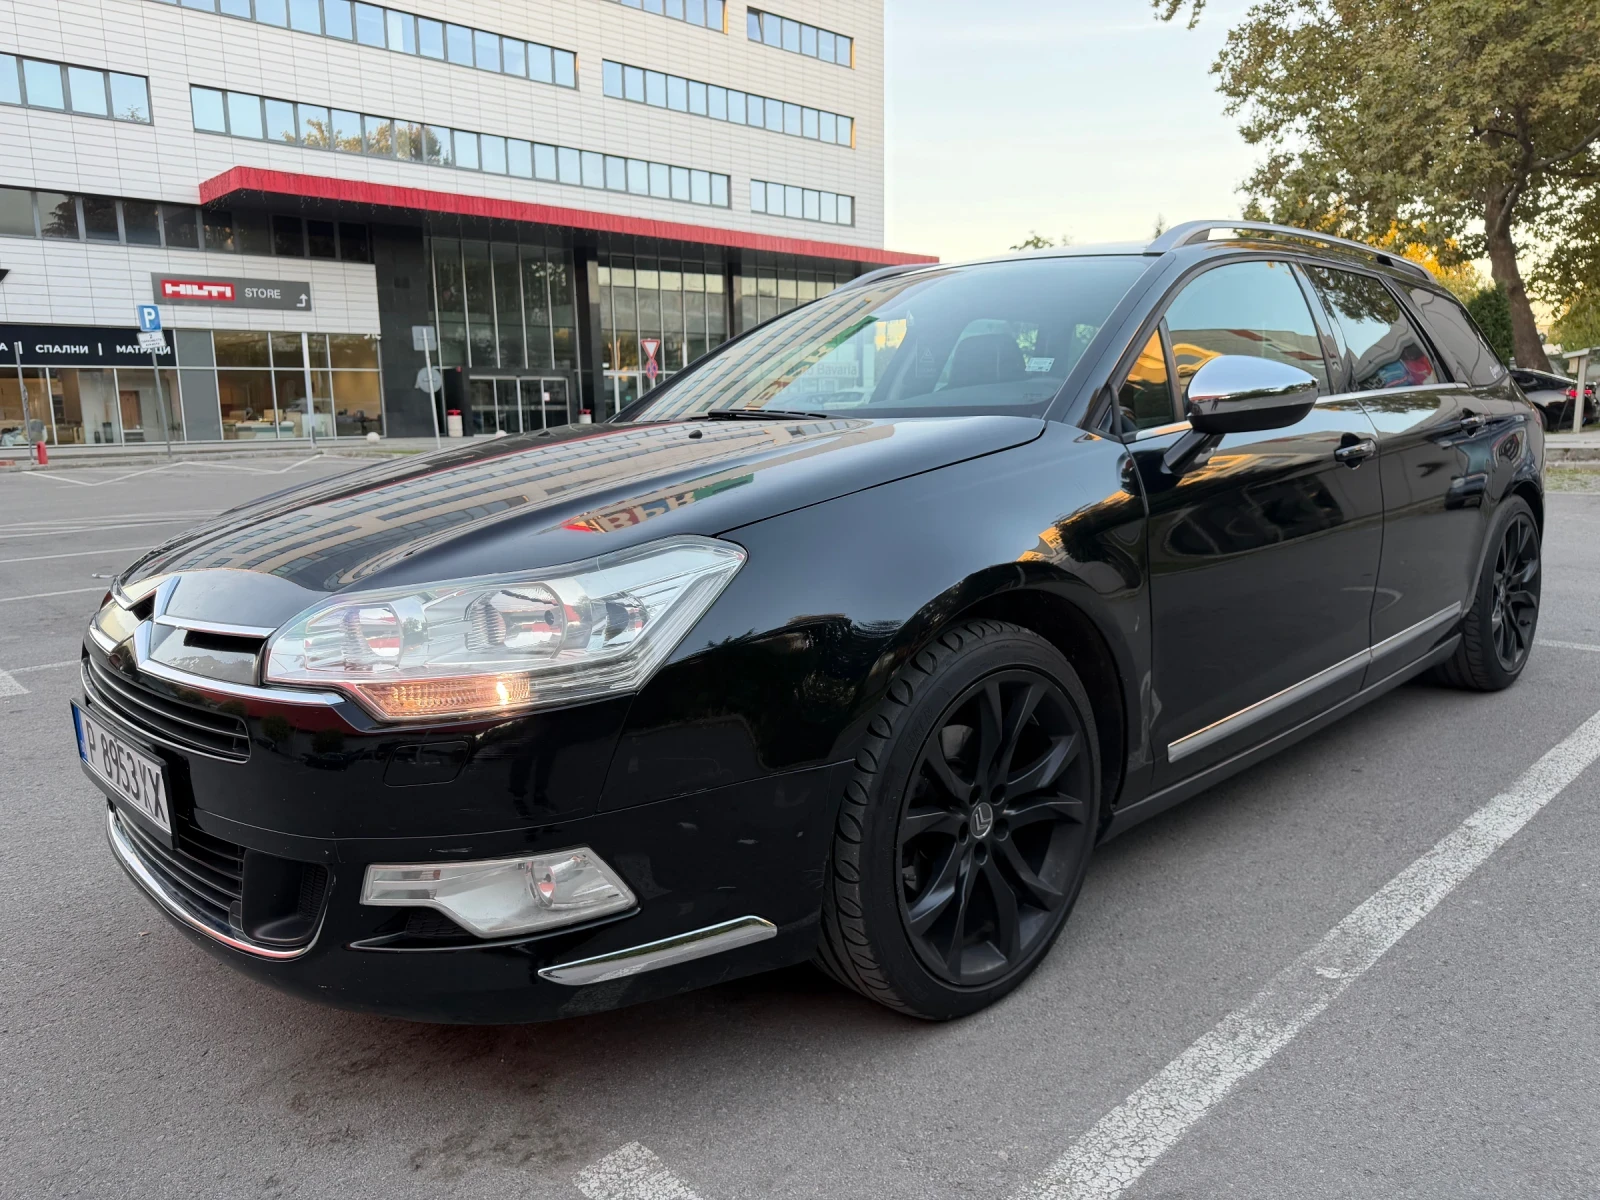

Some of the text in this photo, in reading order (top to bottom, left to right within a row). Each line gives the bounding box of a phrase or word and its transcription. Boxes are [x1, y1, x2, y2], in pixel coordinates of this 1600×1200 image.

[165, 283, 282, 299] HILTI STORE
[143, 307, 156, 328] P
[35, 344, 89, 354] СПАЛНИ
[818, 364, 857, 376] Bavaria
